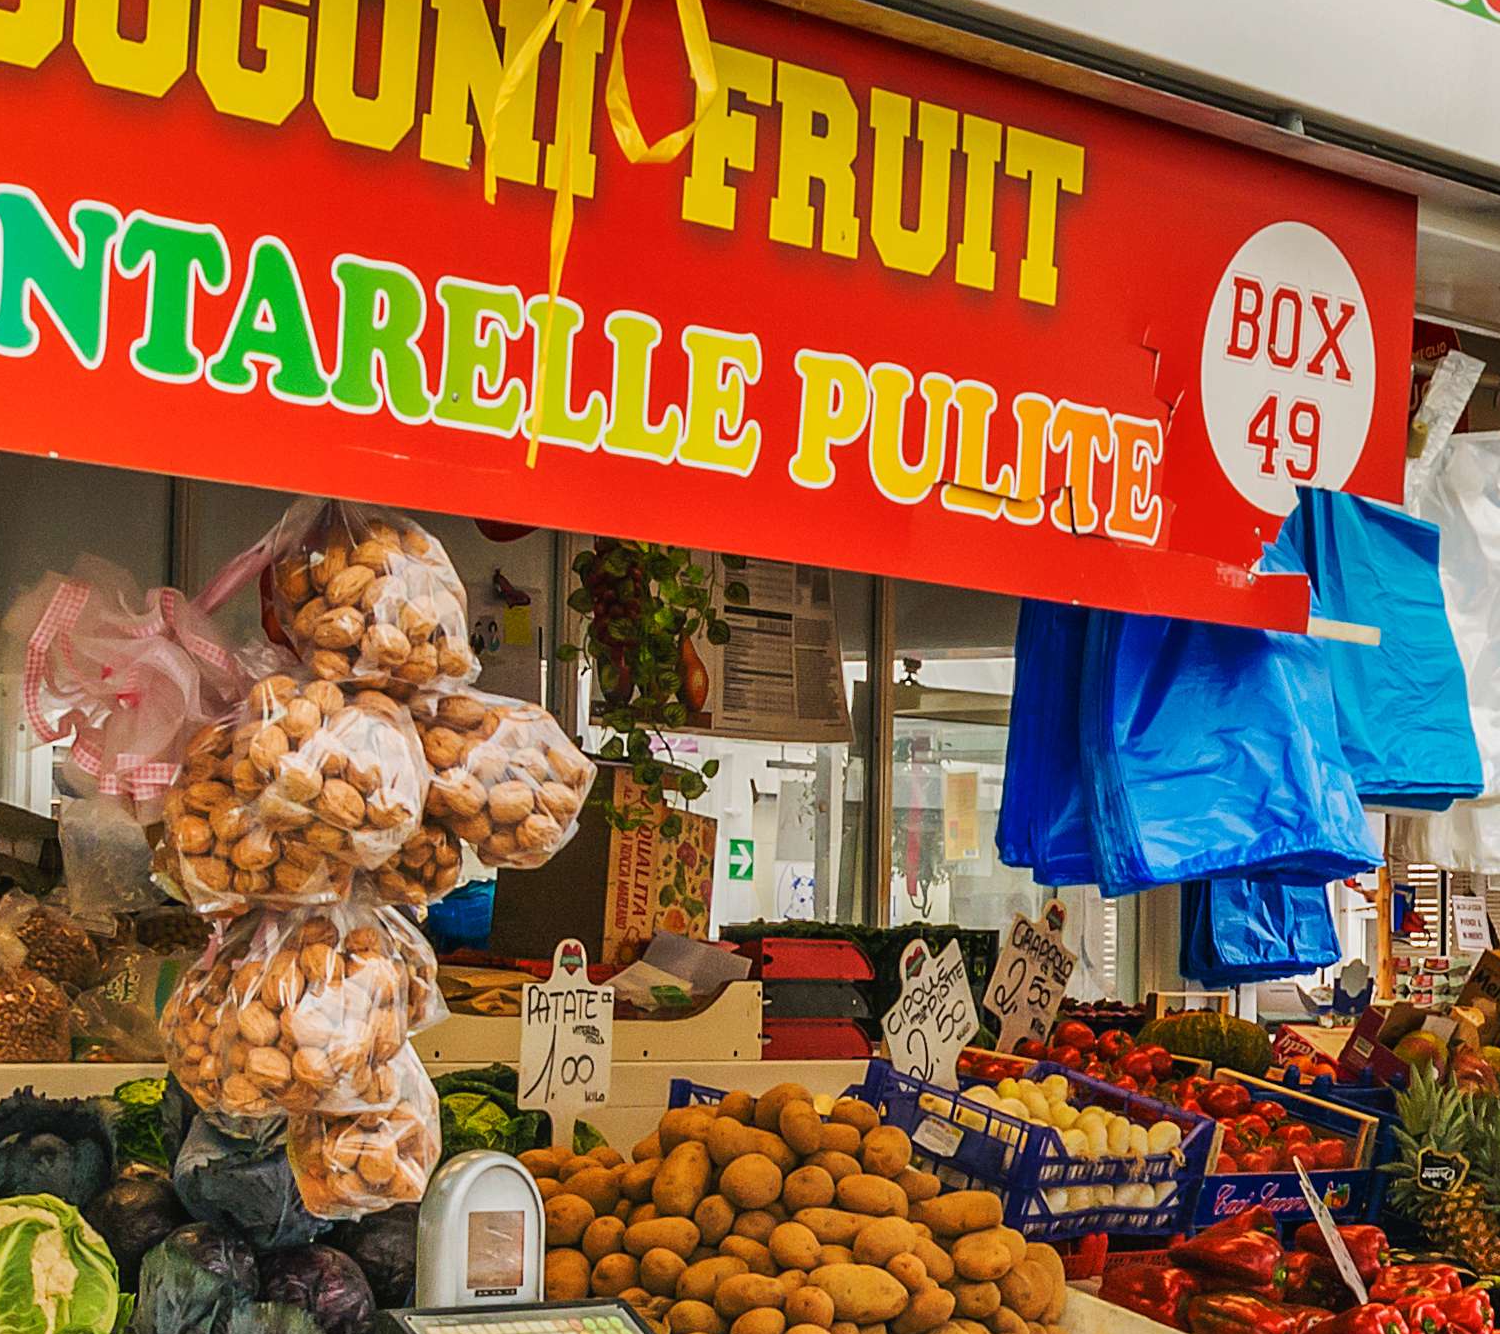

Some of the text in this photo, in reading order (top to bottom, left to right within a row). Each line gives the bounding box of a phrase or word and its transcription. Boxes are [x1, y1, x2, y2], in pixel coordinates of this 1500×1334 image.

[680, 47, 1087, 305] FRUIT
[1224, 274, 1357, 385] BOX
[790, 349, 1164, 545] PULITE
[1245, 390, 1323, 482] 49
[528, 985, 598, 1025] PATATE
